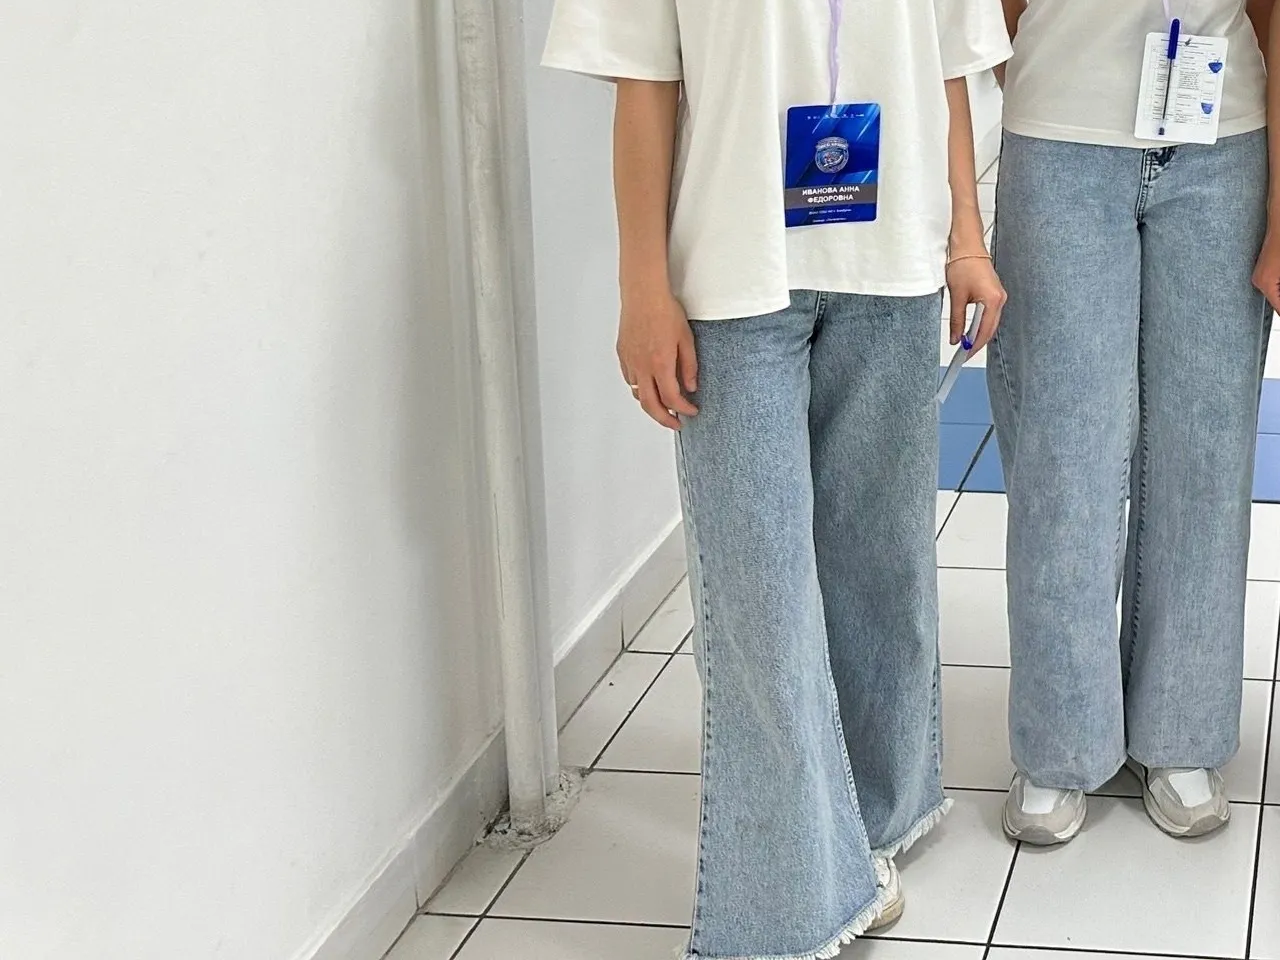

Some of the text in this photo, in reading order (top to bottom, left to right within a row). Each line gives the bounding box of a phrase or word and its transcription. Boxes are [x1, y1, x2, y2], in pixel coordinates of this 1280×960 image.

[802, 185, 860, 196] ИВАНОВА АННА
[807, 194, 854, 204] ФЕДОРОВНА
